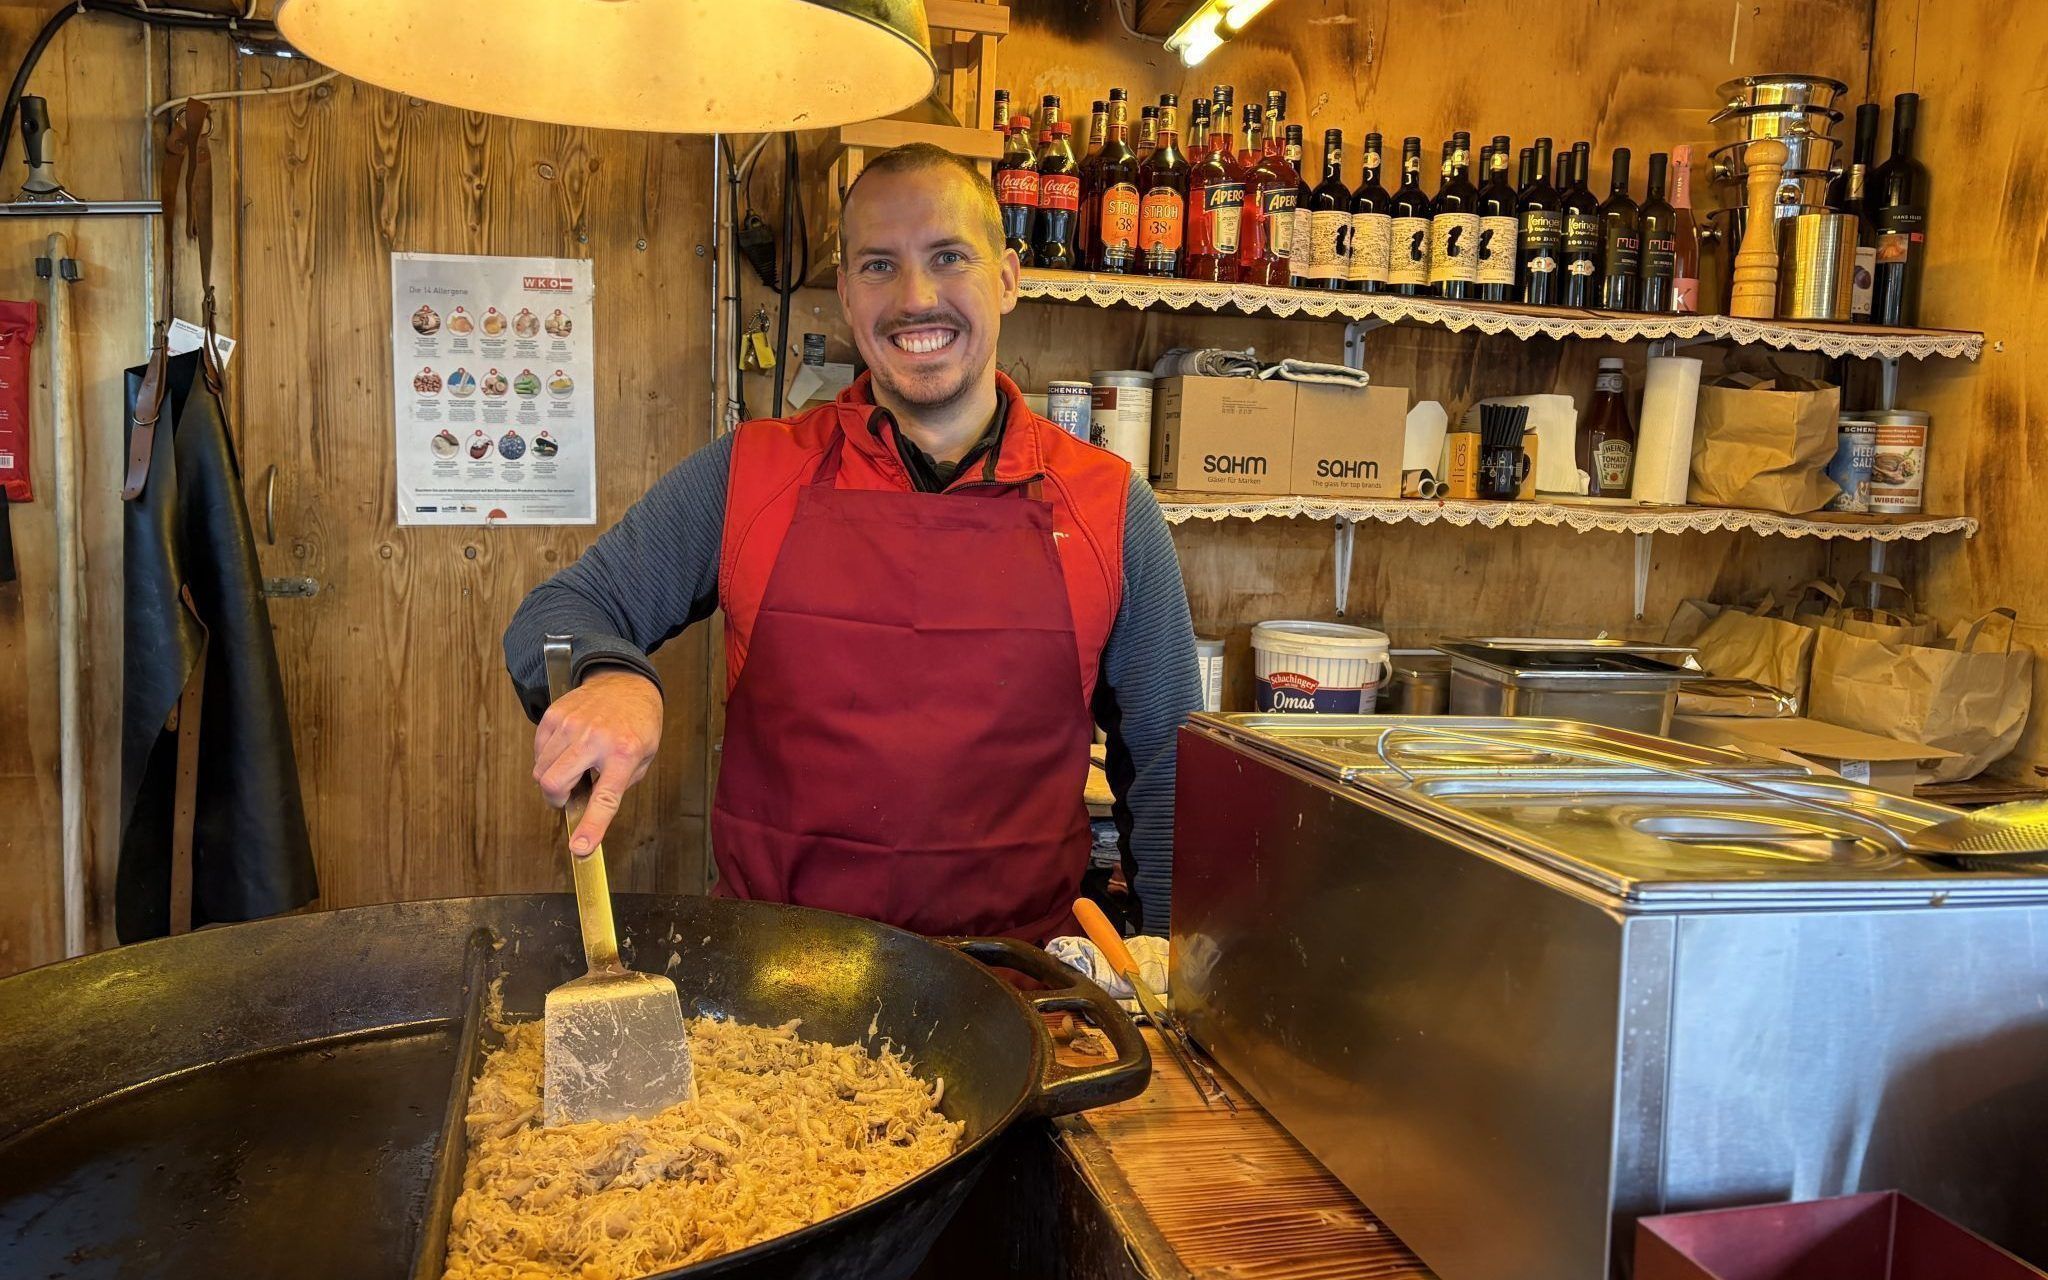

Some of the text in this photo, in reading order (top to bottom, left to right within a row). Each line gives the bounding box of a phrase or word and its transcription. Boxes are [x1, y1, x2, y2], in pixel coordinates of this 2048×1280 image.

[1144, 204, 1178, 219] STROH
[1118, 217, 1133, 232] 38
[1152, 221, 1168, 235] 38
[1528, 214, 1560, 234] Keringe
[525, 278, 560, 288] WKO
[409, 285, 421, 294] Die
[433, 286, 469, 296] Allergene
[1604, 443, 1626, 454] HEINZ
[1602, 455, 1627, 463] TOMATO
[1238, 477, 1261, 485] Marken
[1312, 479, 1382, 489] The glass for top brands
[1874, 496, 1905, 504] WIBERG
[1270, 674, 1317, 690] Schachinger
[1273, 691, 1316, 710] Omas
